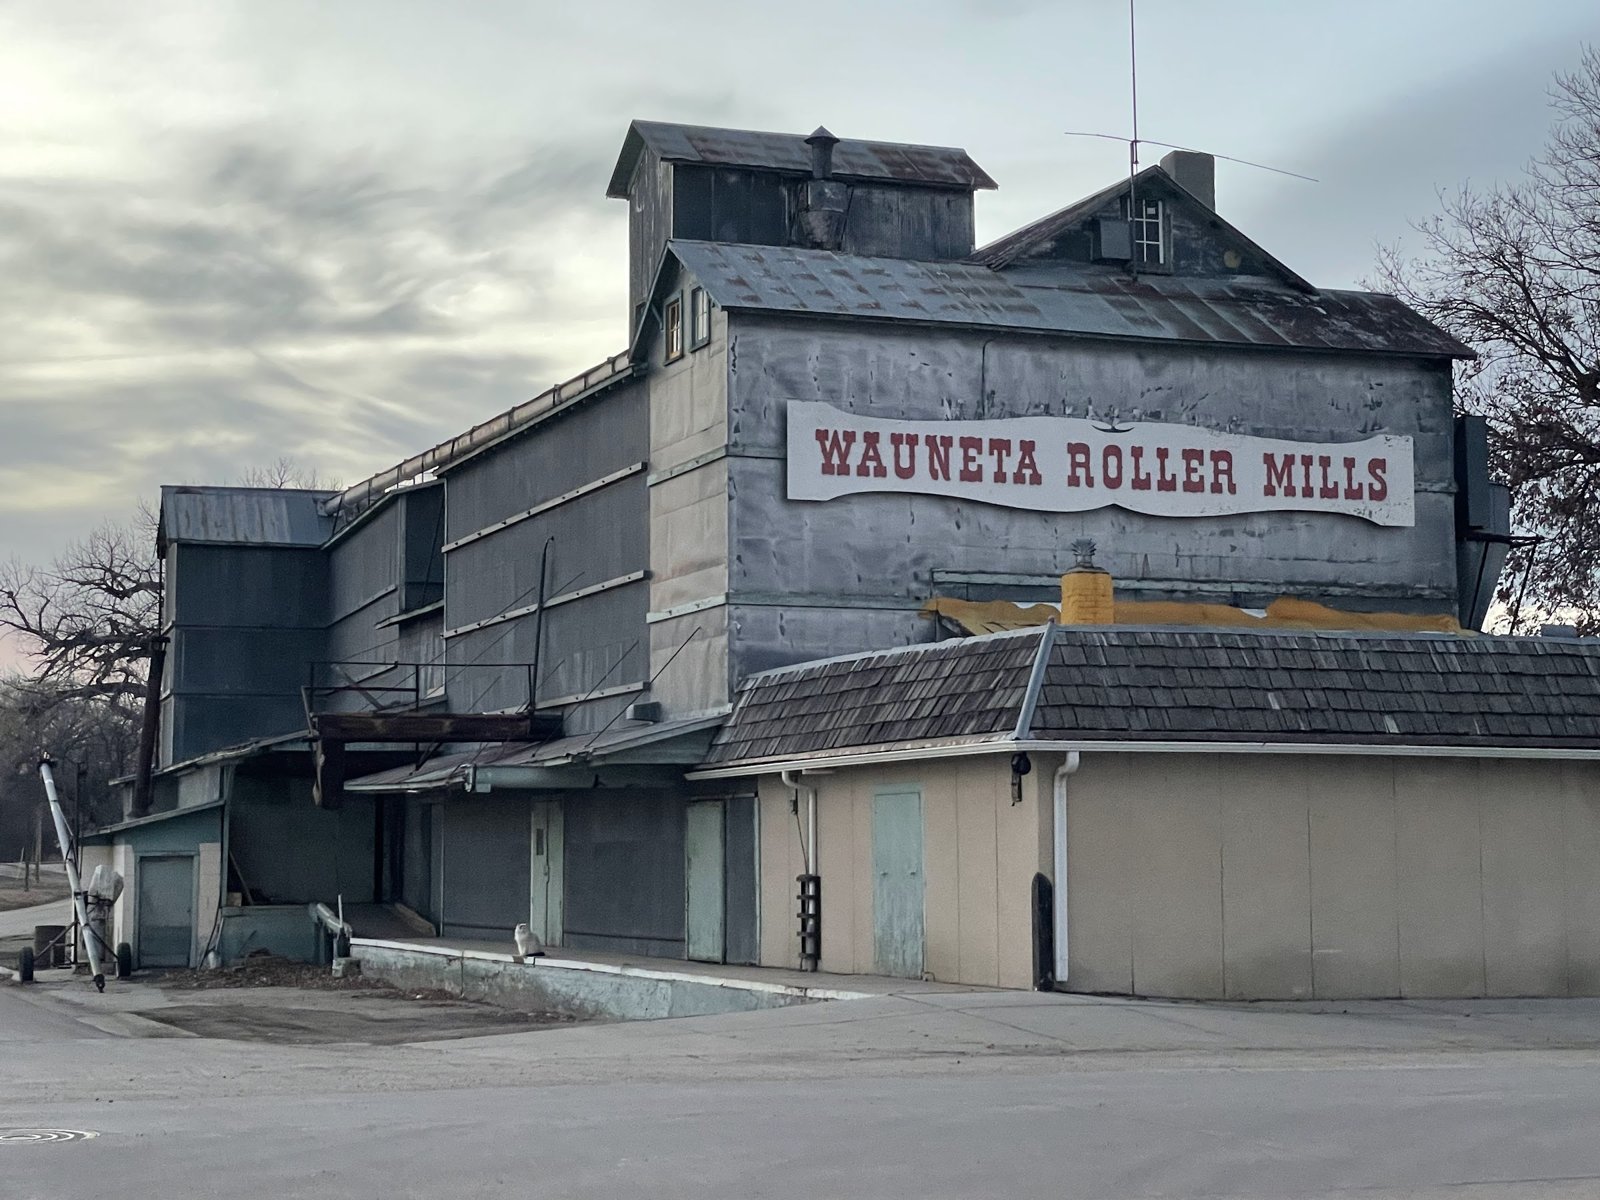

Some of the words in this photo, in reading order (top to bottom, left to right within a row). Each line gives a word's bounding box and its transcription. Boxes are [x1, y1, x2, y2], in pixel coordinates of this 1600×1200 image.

[815, 428, 1042, 486] WAUNETA
[1067, 442, 1237, 494] ROLLER
[1263, 452, 1388, 502] MILLS
